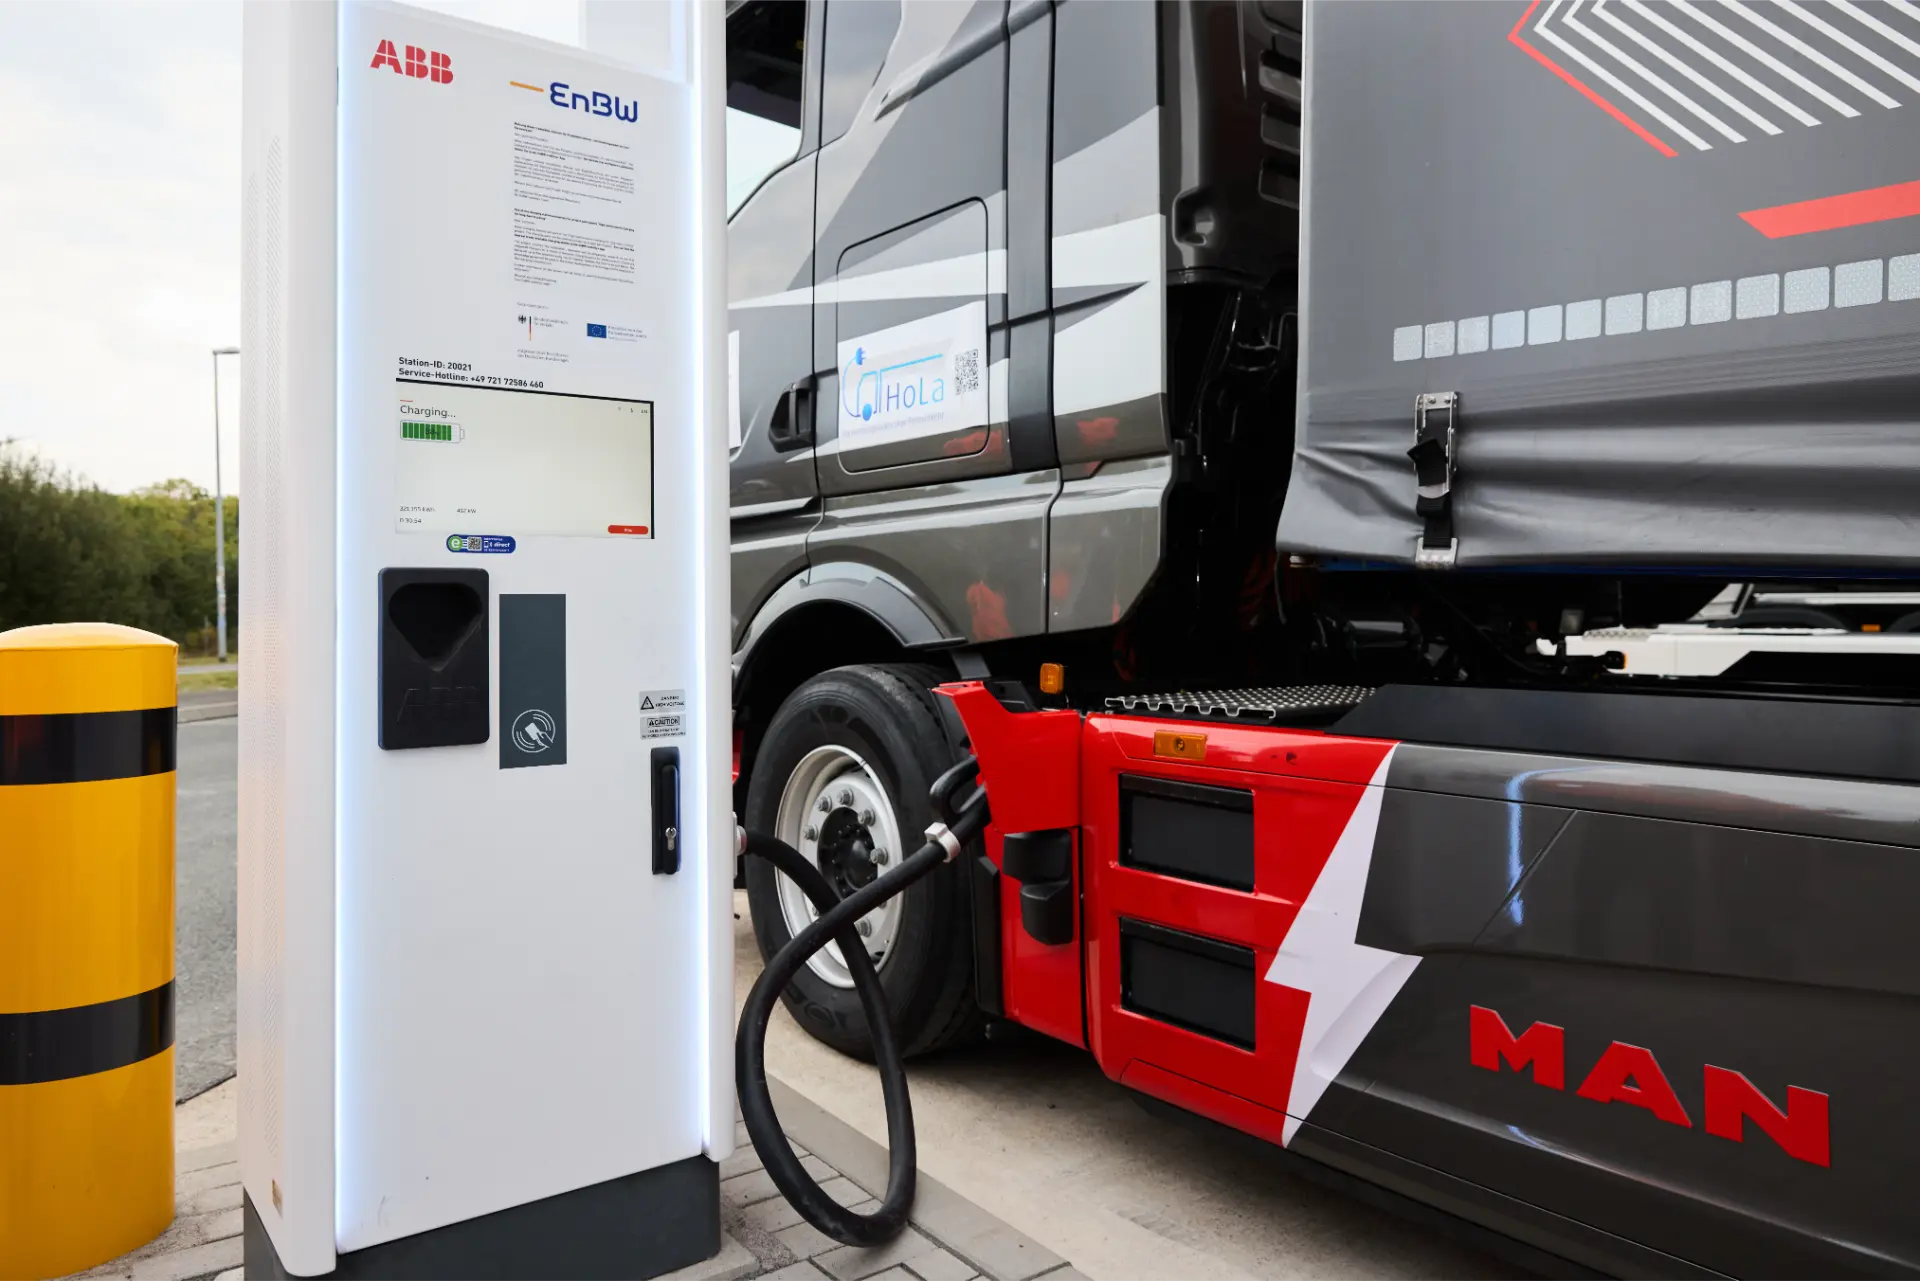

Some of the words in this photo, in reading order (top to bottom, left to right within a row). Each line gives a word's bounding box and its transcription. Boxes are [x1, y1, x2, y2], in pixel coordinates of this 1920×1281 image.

[370, 39, 454, 84] ABB
[550, 82, 638, 123] EnBW
[398, 356, 446, 369] Station-ID:
[447, 362, 472, 372] 20021
[398, 367, 469, 382] Service-Hotline:
[470, 375, 485, 383] +49
[487, 376, 502, 385] 721
[503, 378, 528, 388] 72586
[529, 380, 544, 389] 460
[887, 377, 945, 412] HoLa
[400, 404, 456, 419] Charging...
[654, 718, 679, 726] CAUTION
[1470, 1003, 1831, 1169] MAN
